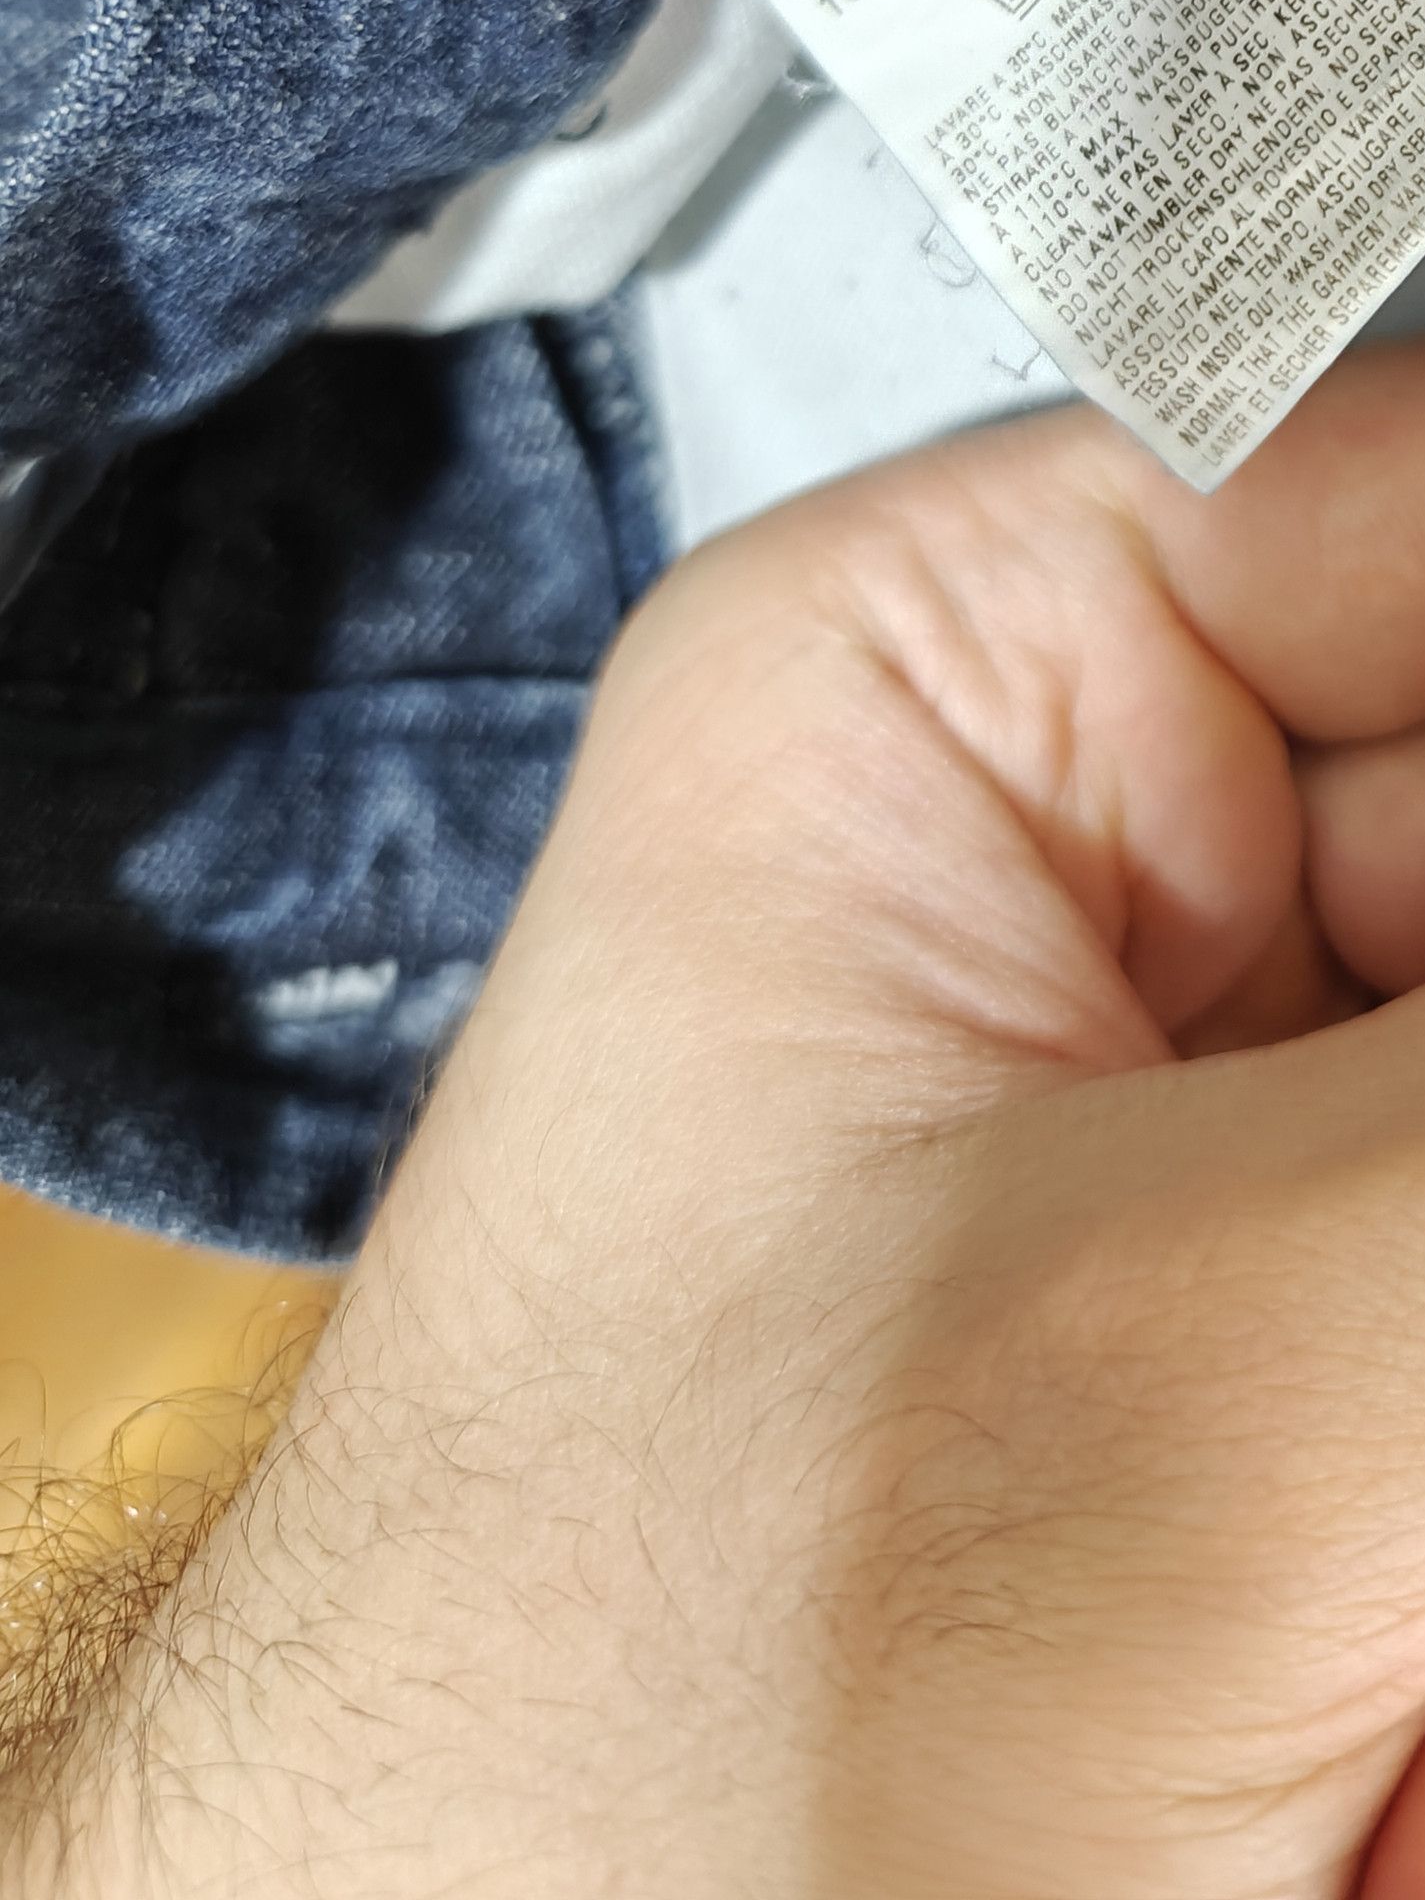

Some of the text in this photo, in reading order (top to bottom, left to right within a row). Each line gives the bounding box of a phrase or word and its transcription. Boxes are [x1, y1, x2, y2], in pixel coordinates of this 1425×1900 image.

[922, 84, 992, 151] LAVARE
[960, 171, 995, 203] NE
[994, 131, 1041, 172] PAS
[981, 141, 1062, 216] STIRARE
[1011, 85, 1058, 129] NON
[1054, 25, 1119, 88] USARE
[1036, 267, 1074, 303] NO
[1072, 200, 1141, 269] LAVAR
[1140, 169, 1173, 201] EN
[1240, 47, 1288, 97] NON
[1056, 292, 1089, 325] DO
[1085, 248, 1129, 295] NOT
[1125, 167, 1210, 253] TUMBLER
[1207, 124, 1249, 170] DRY
[1246, 96, 1278, 128] NE
[1273, 56, 1315, 100] PAS
[1073, 282, 1136, 347] NICHT
[1326, 44, 1361, 79] NO
[1090, 184, 1123, 215] NE
[1118, 147, 1160, 189] PAS
[1157, 88, 1217, 151] LAVER
[1092, 128, 1144, 179] MAX
[1162, 61, 1210, 110] NON
[1088, 293, 1165, 370] LAVARE
[1159, 277, 1184, 299] IL
[1180, 225, 1231, 278] CAPO
[1227, 201, 1256, 229] AL
[1251, 107, 1339, 201] ROVESCIO
[1334, 90, 1354, 111] E
[1111, 229, 1265, 390] ASSOLUTAMENTE
[1259, 141, 1346, 234] NORMALI
[1130, 322, 1211, 405] TESSUTO
[1207, 288, 1248, 327] NEL
[1313, 103, 1416, 218] ASCIUGARE
[1154, 378, 1201, 425] WASH
[1196, 323, 1251, 381] INSIDE
[1282, 233, 1336, 286] WASH
[1333, 195, 1371, 237] AND
[1366, 157, 1403, 199] DRY
[1178, 377, 1247, 448] NORMAL
[1238, 331, 1283, 379] THAT
[1277, 296, 1316, 335] THE
[1310, 209, 1393, 300] GARMENT
[1201, 411, 1251, 467] LAVER
[1247, 387, 1272, 413] ET
[1267, 324, 1330, 391] SECHER
